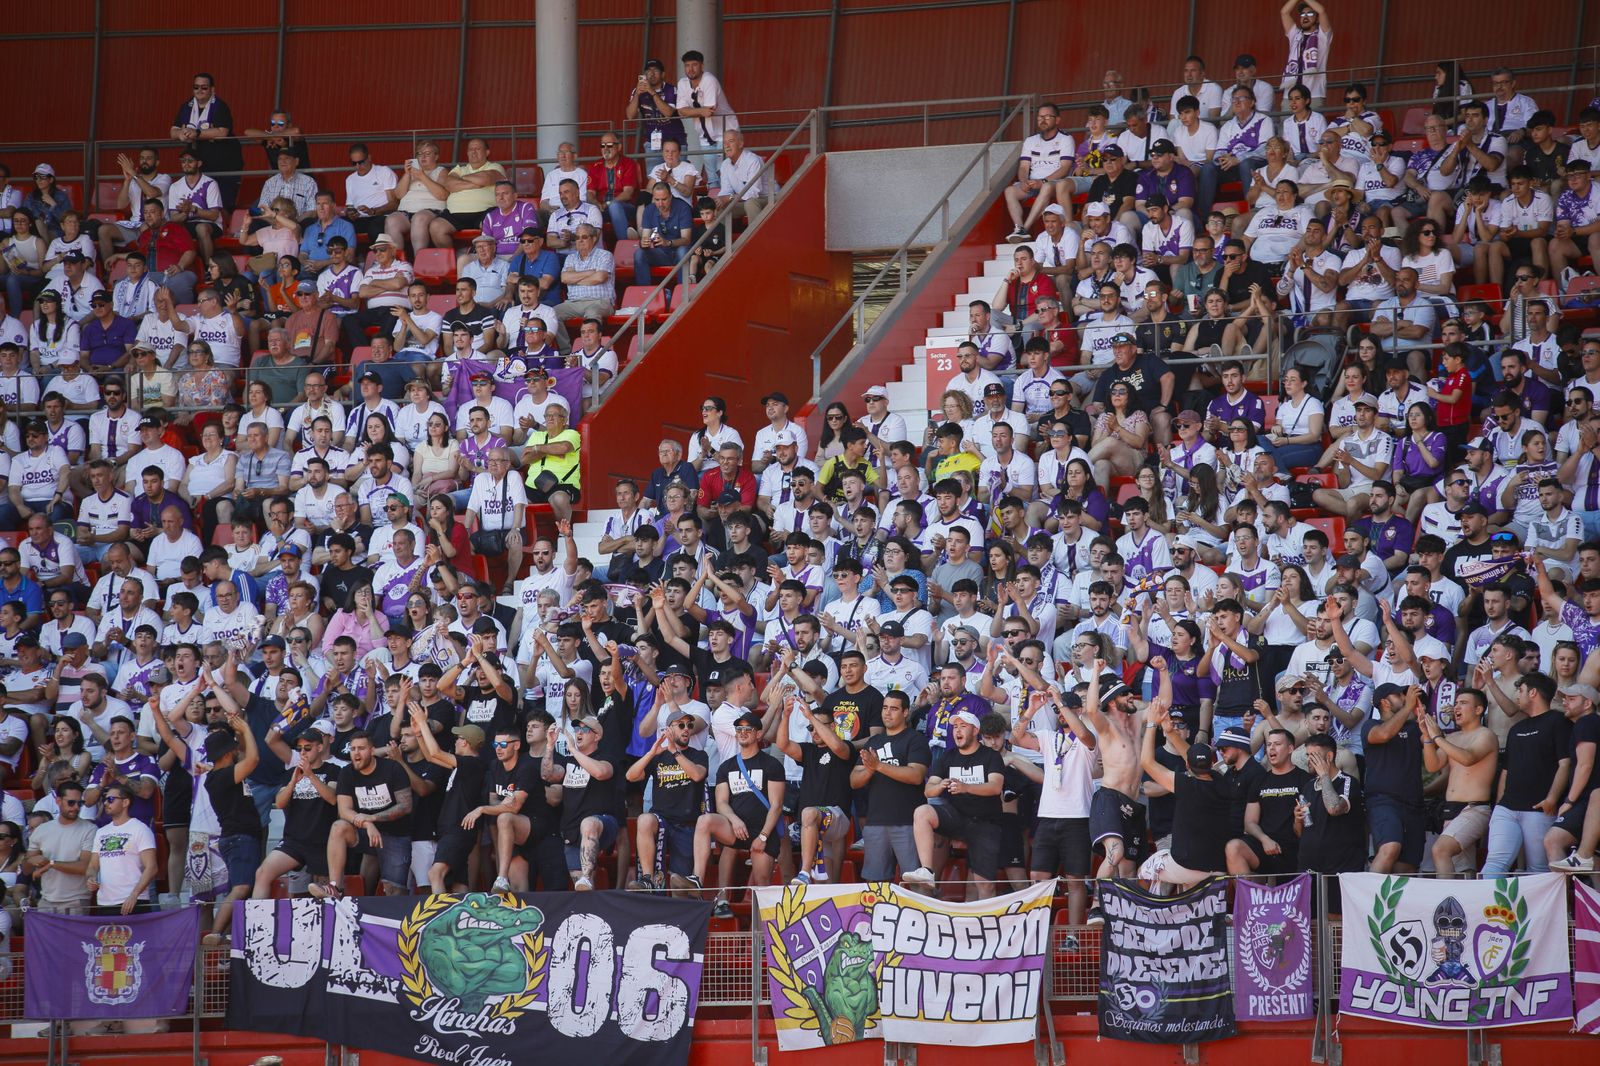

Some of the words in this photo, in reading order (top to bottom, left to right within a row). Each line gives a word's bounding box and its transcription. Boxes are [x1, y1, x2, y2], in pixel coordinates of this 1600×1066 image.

[936, 358, 953, 371] 23
[547, 912, 690, 1042] 06
[410, 996, 517, 1038] Hinchas
[1350, 975, 1471, 1022] YOUNG
[1480, 978, 1559, 1020] TNF
[413, 1034, 470, 1064] Real
